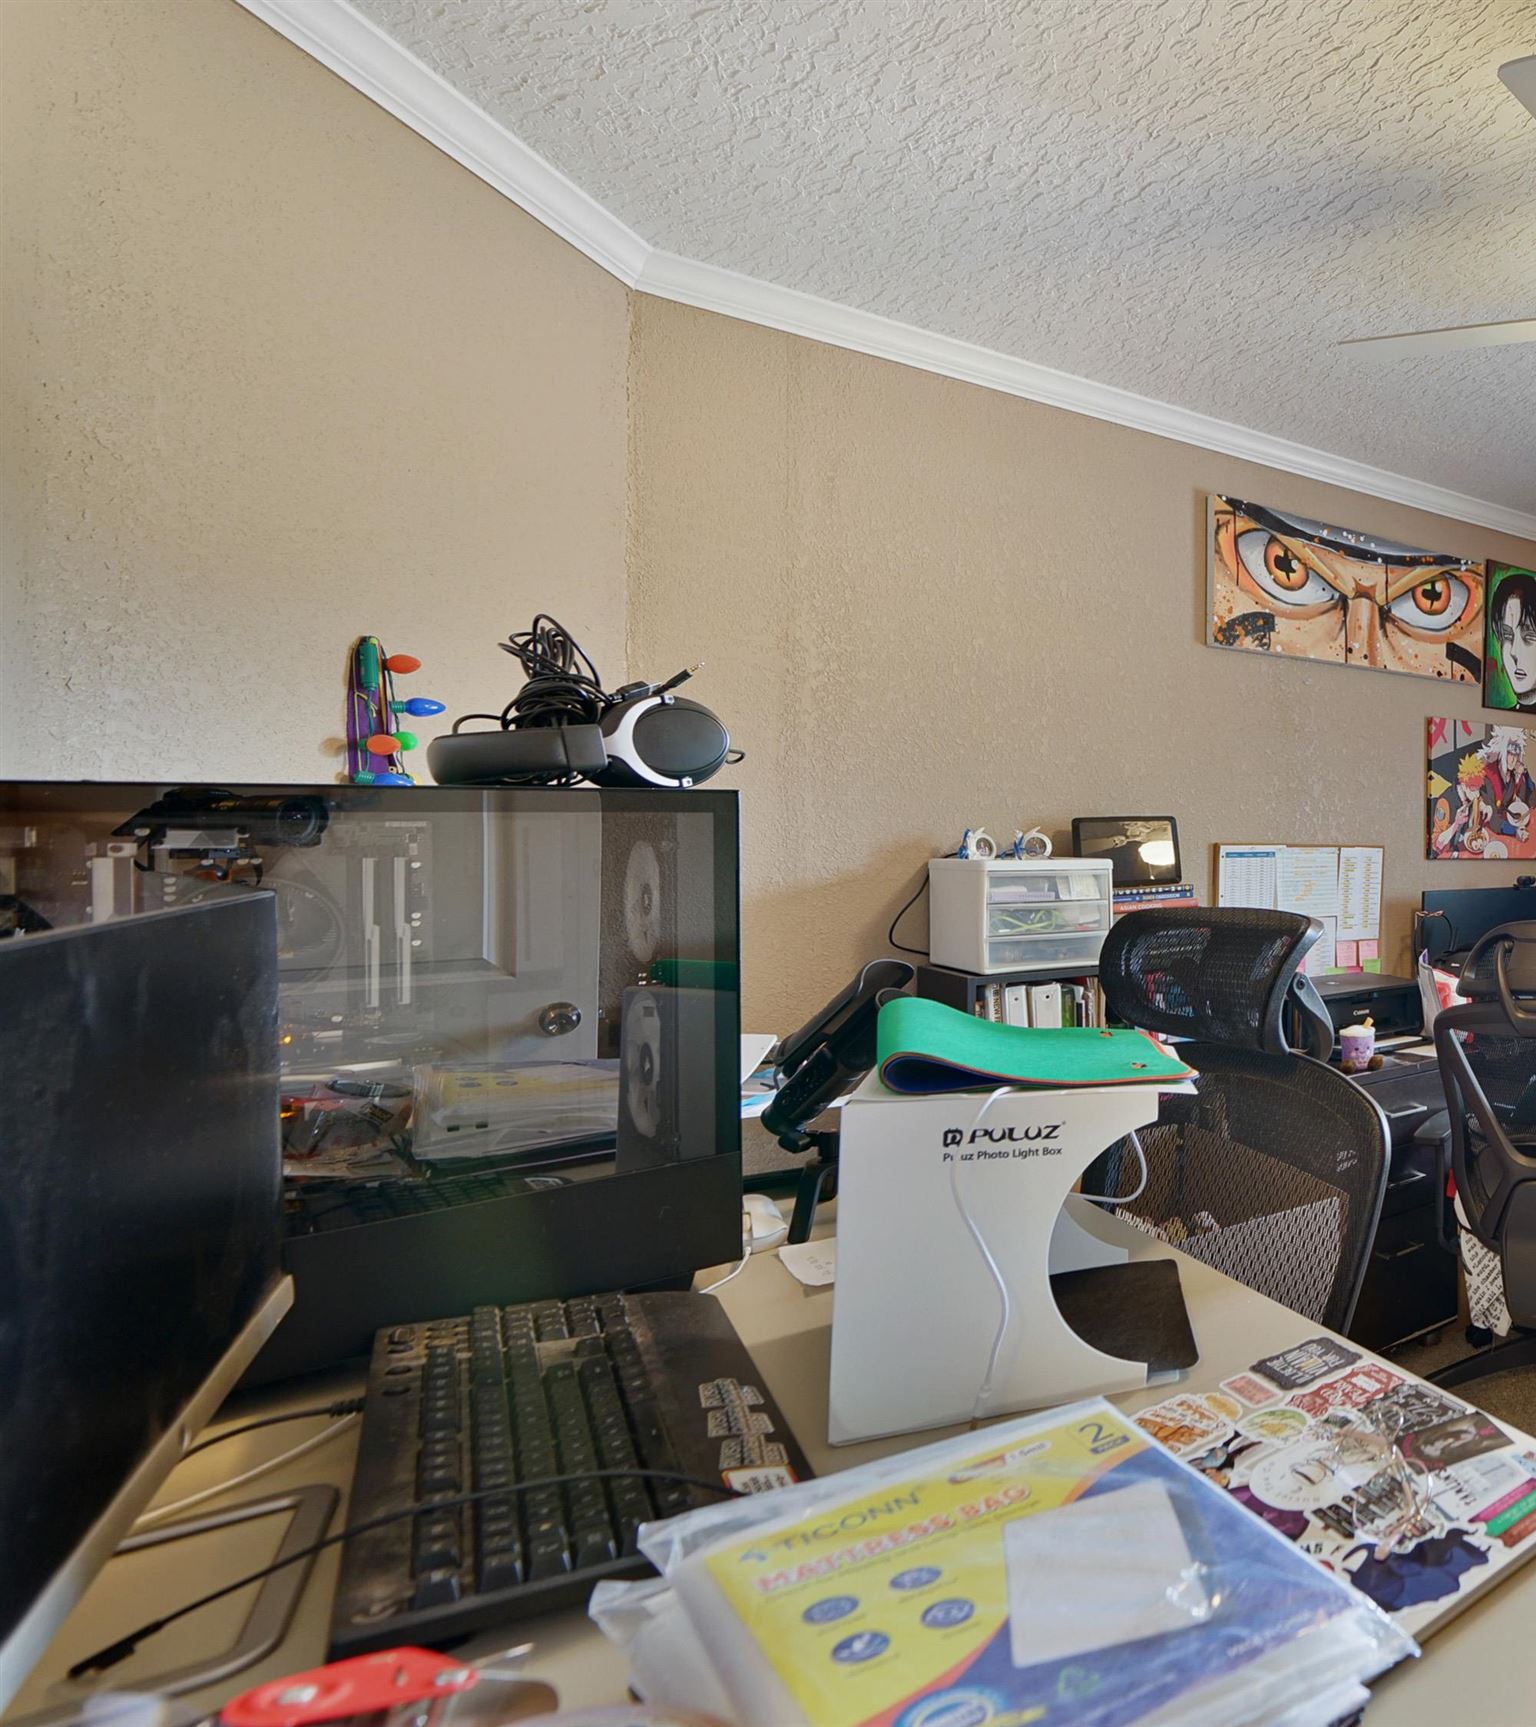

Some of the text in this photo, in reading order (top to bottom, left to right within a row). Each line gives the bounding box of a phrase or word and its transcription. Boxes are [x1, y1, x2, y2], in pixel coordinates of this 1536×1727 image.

[967, 1124, 1062, 1144] PULUZ
[943, 1146, 1062, 1162] Puz Photo Light Box
[1079, 1422, 1114, 1445] 2
[958, 1485, 1031, 1520] BAG
[783, 1490, 920, 1550] TICONN
[757, 1512, 957, 1592] MATTRESS
